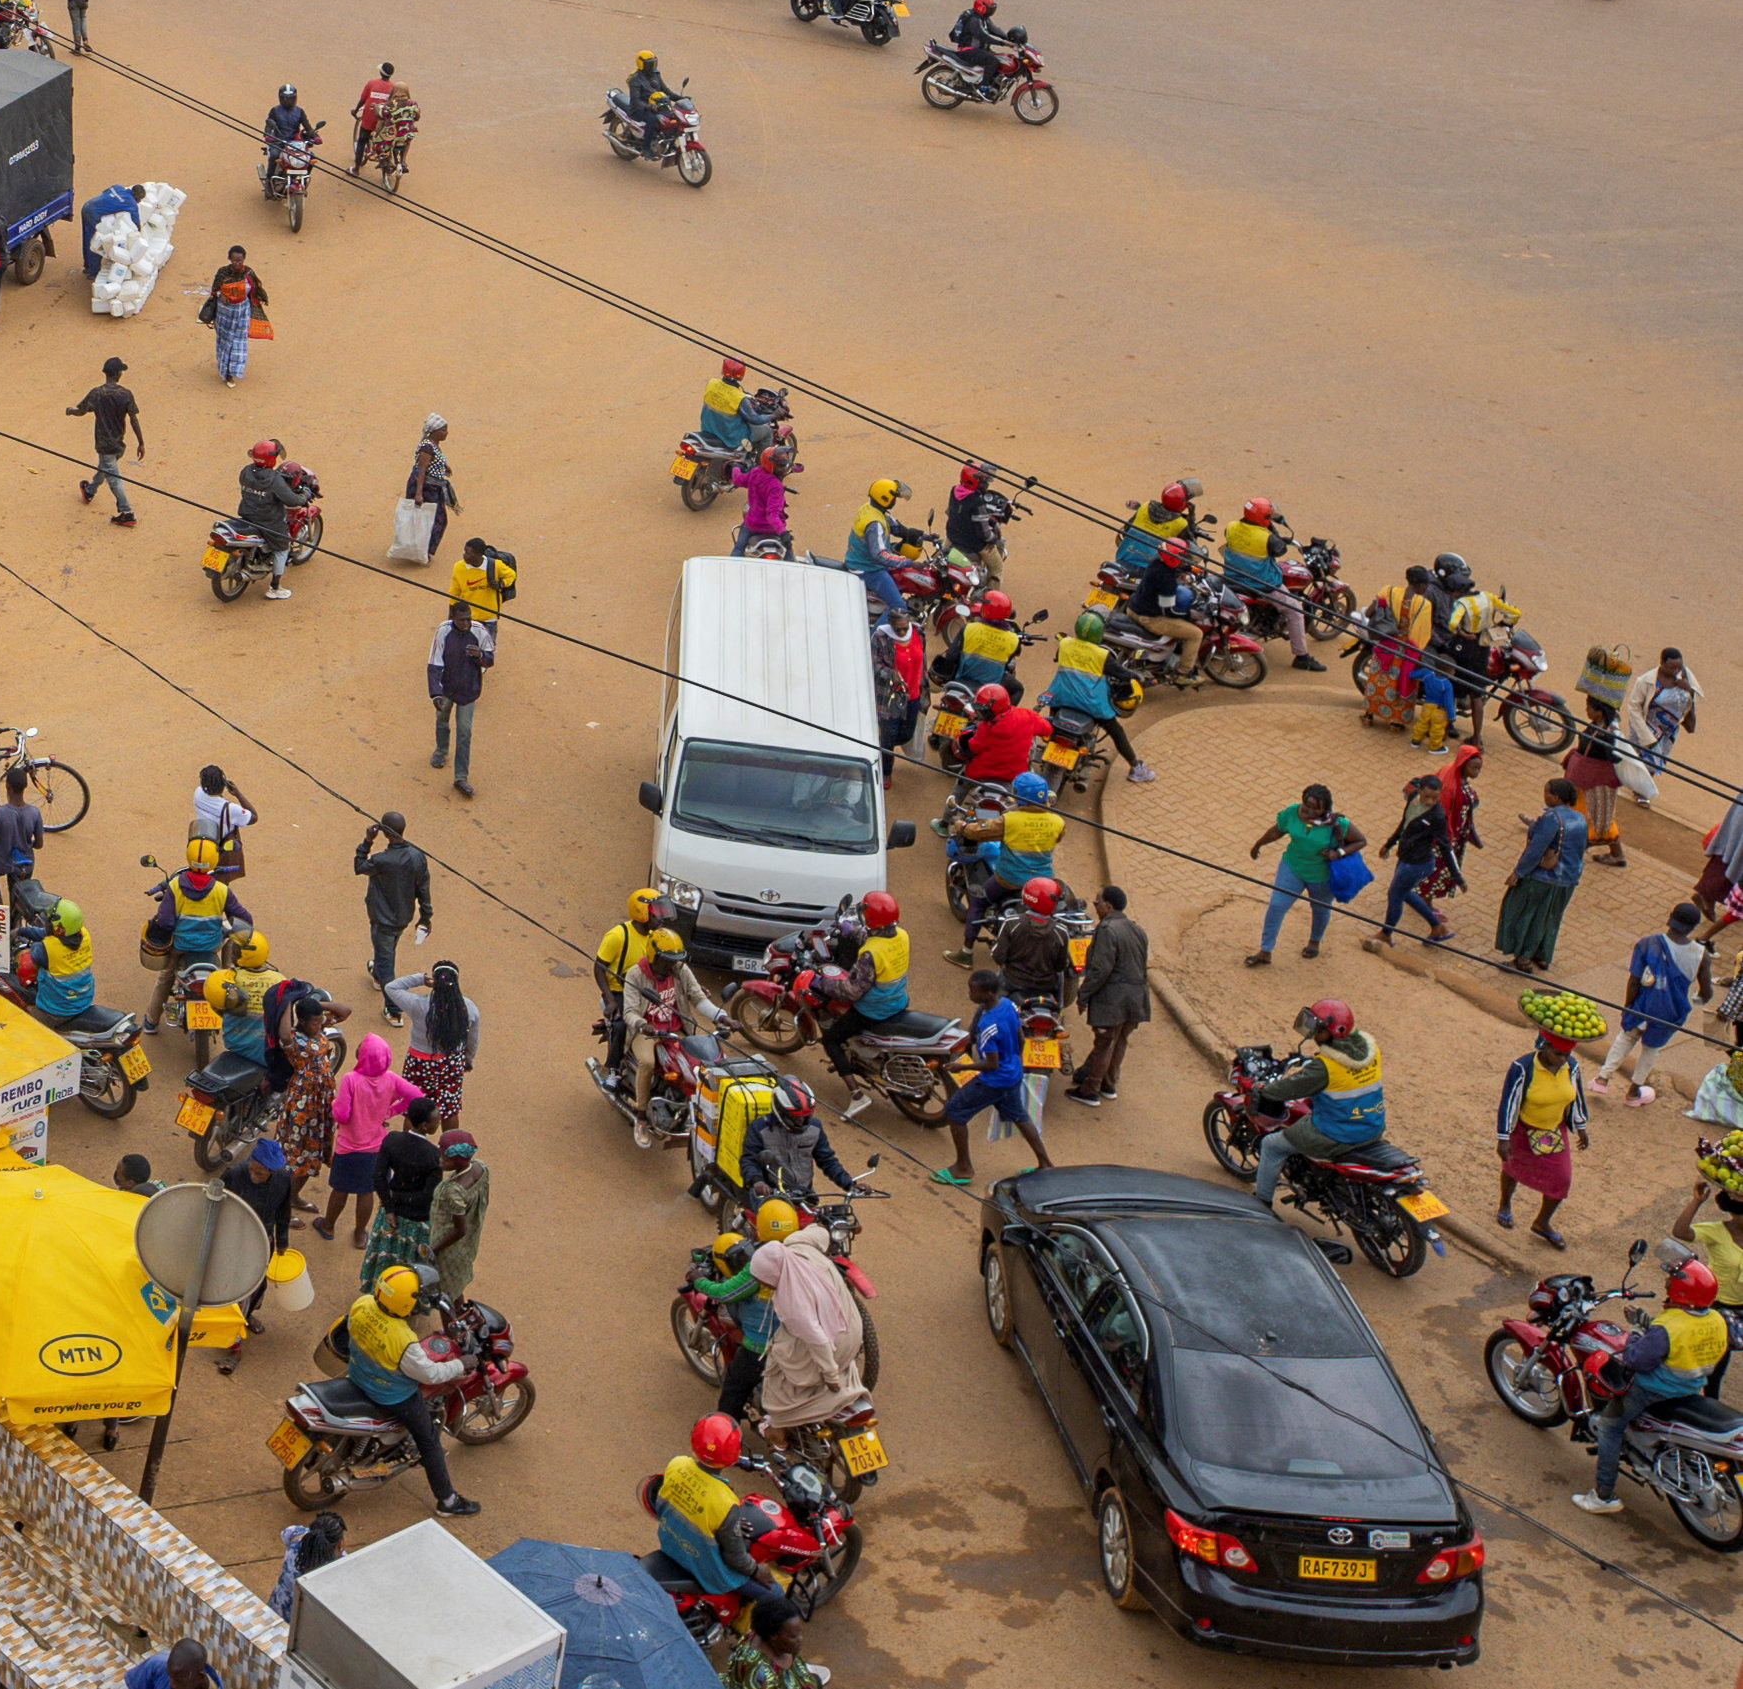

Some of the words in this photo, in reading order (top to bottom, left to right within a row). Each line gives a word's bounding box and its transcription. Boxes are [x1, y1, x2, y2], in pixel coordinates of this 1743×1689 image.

[195, 1002, 209, 1014] RG
[11, 1093, 42, 1113] rura
[55, 1086, 74, 1102] RDB
[58, 1346, 103, 1365] MTN
[33, 1402, 102, 1414] everywhere
[102, 1401, 124, 1413] you
[125, 1400, 143, 1411] go
[282, 1424, 301, 1446] RG
[270, 1434, 296, 1465] 875G
[850, 1448, 883, 1473] 703W
[1302, 1558, 1368, 1578] RAF739J
